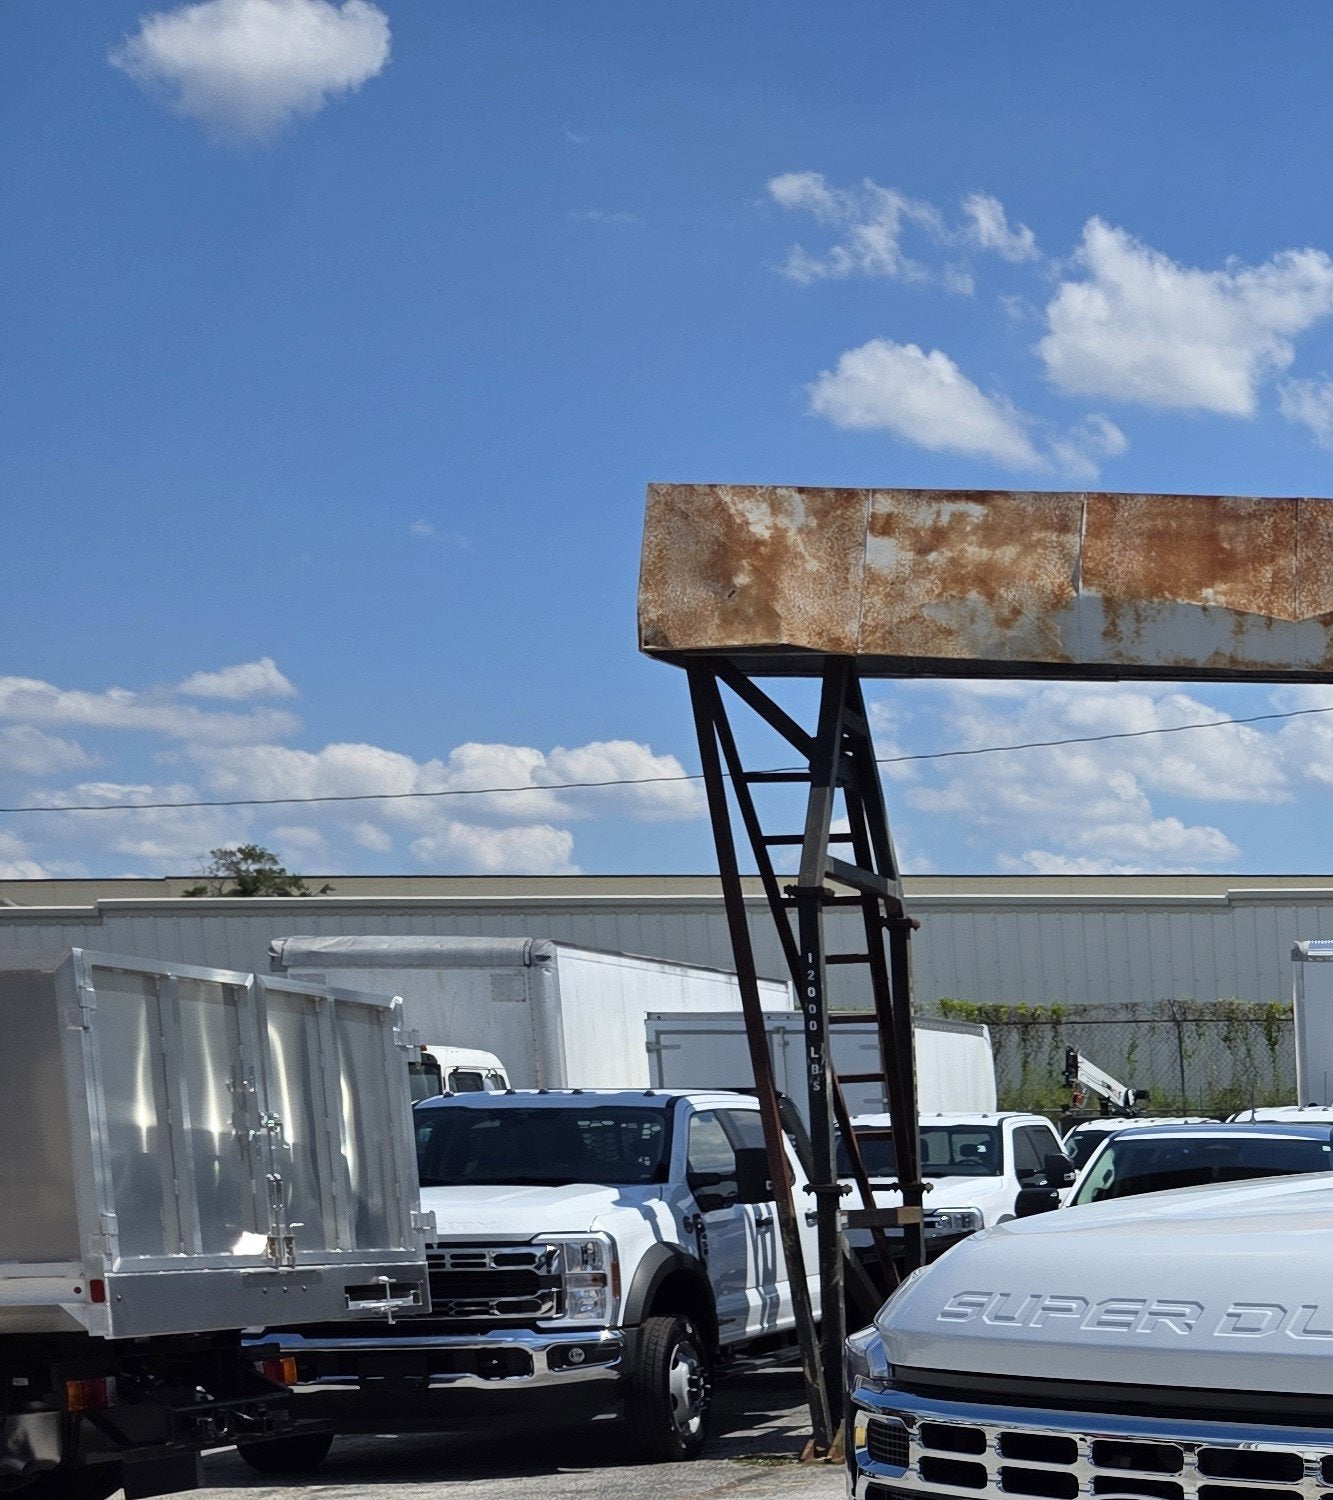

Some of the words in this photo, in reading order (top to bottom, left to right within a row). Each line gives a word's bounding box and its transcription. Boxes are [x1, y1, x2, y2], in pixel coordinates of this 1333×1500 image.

[806, 952, 818, 1031] 12000
[810, 1046, 821, 1091] LBS
[936, 1290, 1205, 1335] SUPER
